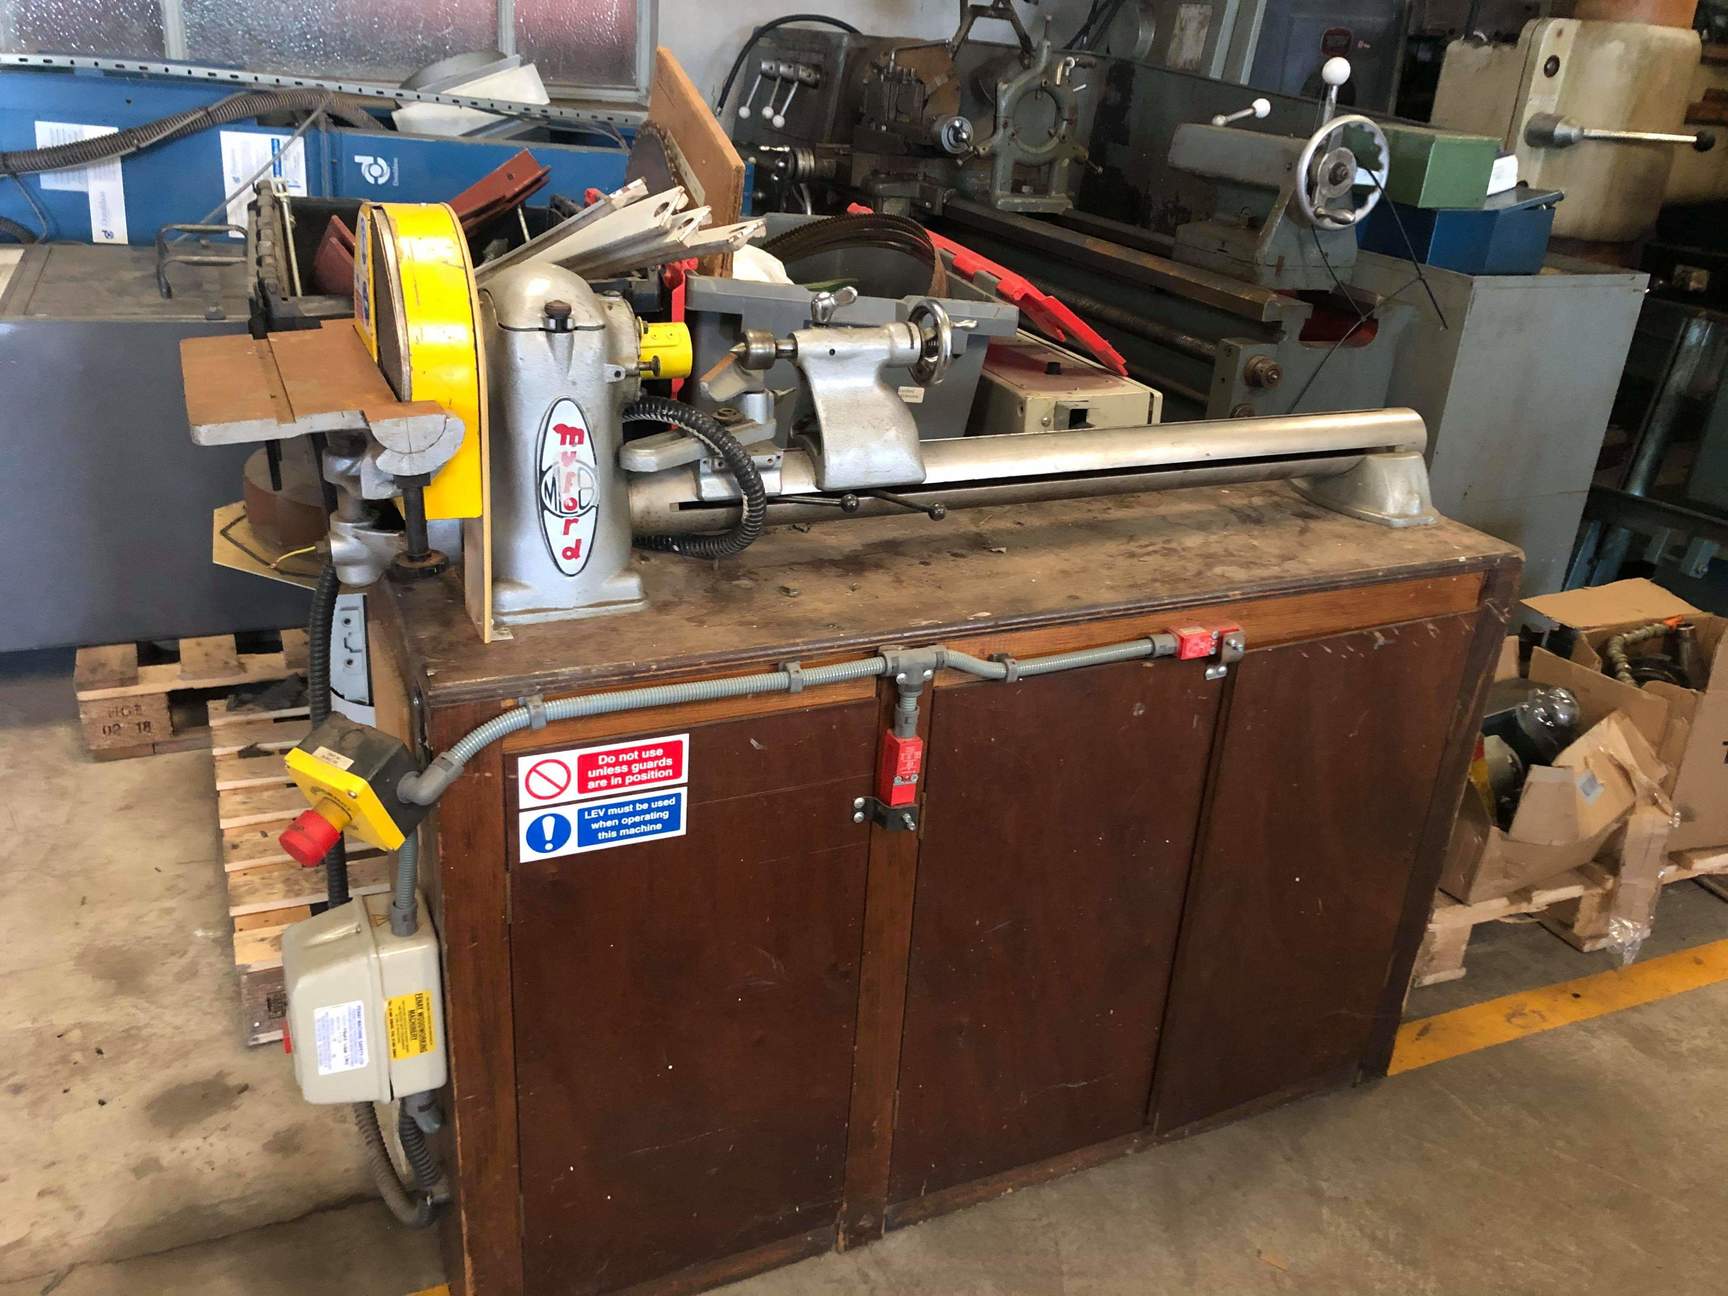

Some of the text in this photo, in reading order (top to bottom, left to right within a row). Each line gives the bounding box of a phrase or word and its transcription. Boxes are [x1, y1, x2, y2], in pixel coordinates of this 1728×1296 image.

[598, 748, 664, 765] Do not use
[587, 757, 673, 778] unless guards
[587, 768, 673, 789] are in position
[584, 797, 676, 819] LEV must be used
[591, 810, 669, 830] when operating
[597, 823, 663, 840] this machine
